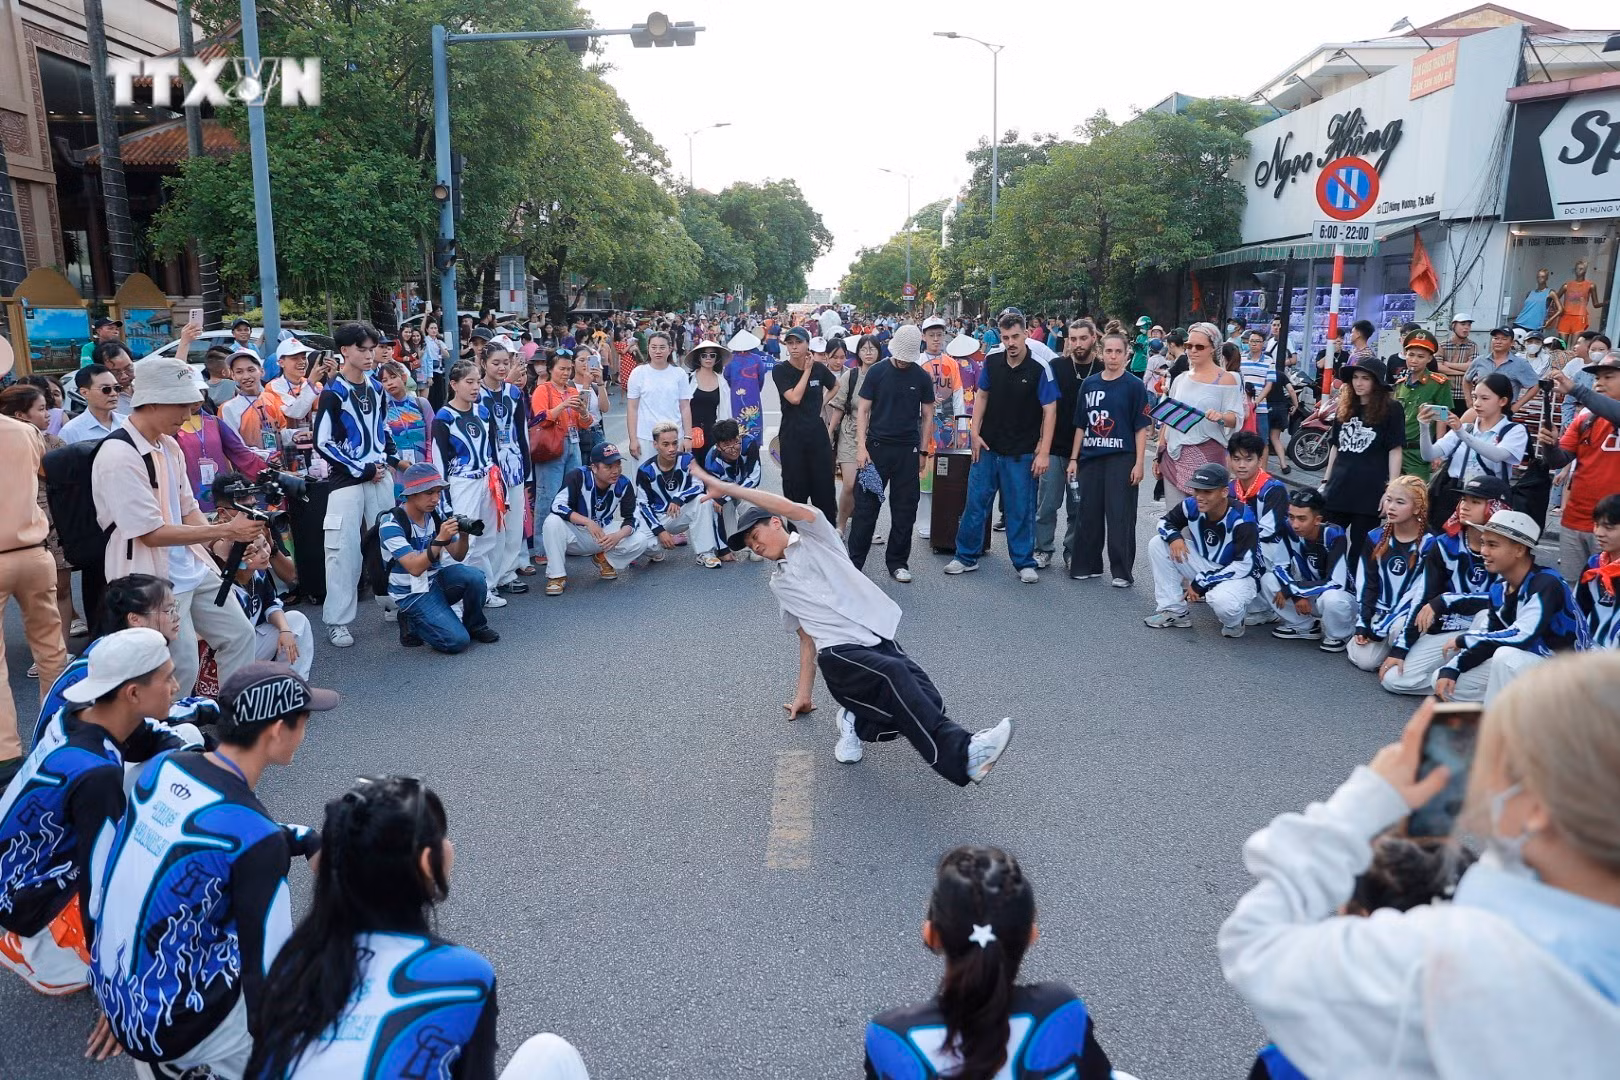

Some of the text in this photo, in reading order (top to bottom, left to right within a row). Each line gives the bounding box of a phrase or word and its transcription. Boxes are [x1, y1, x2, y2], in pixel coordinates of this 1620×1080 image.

[1255, 131, 1313, 199] Ngọc
[1319, 225, 1338, 239] 6:00
[1345, 226, 1369, 240] 22:00
[1088, 409, 1109, 426] OP
[237, 677, 304, 722] NIKE
